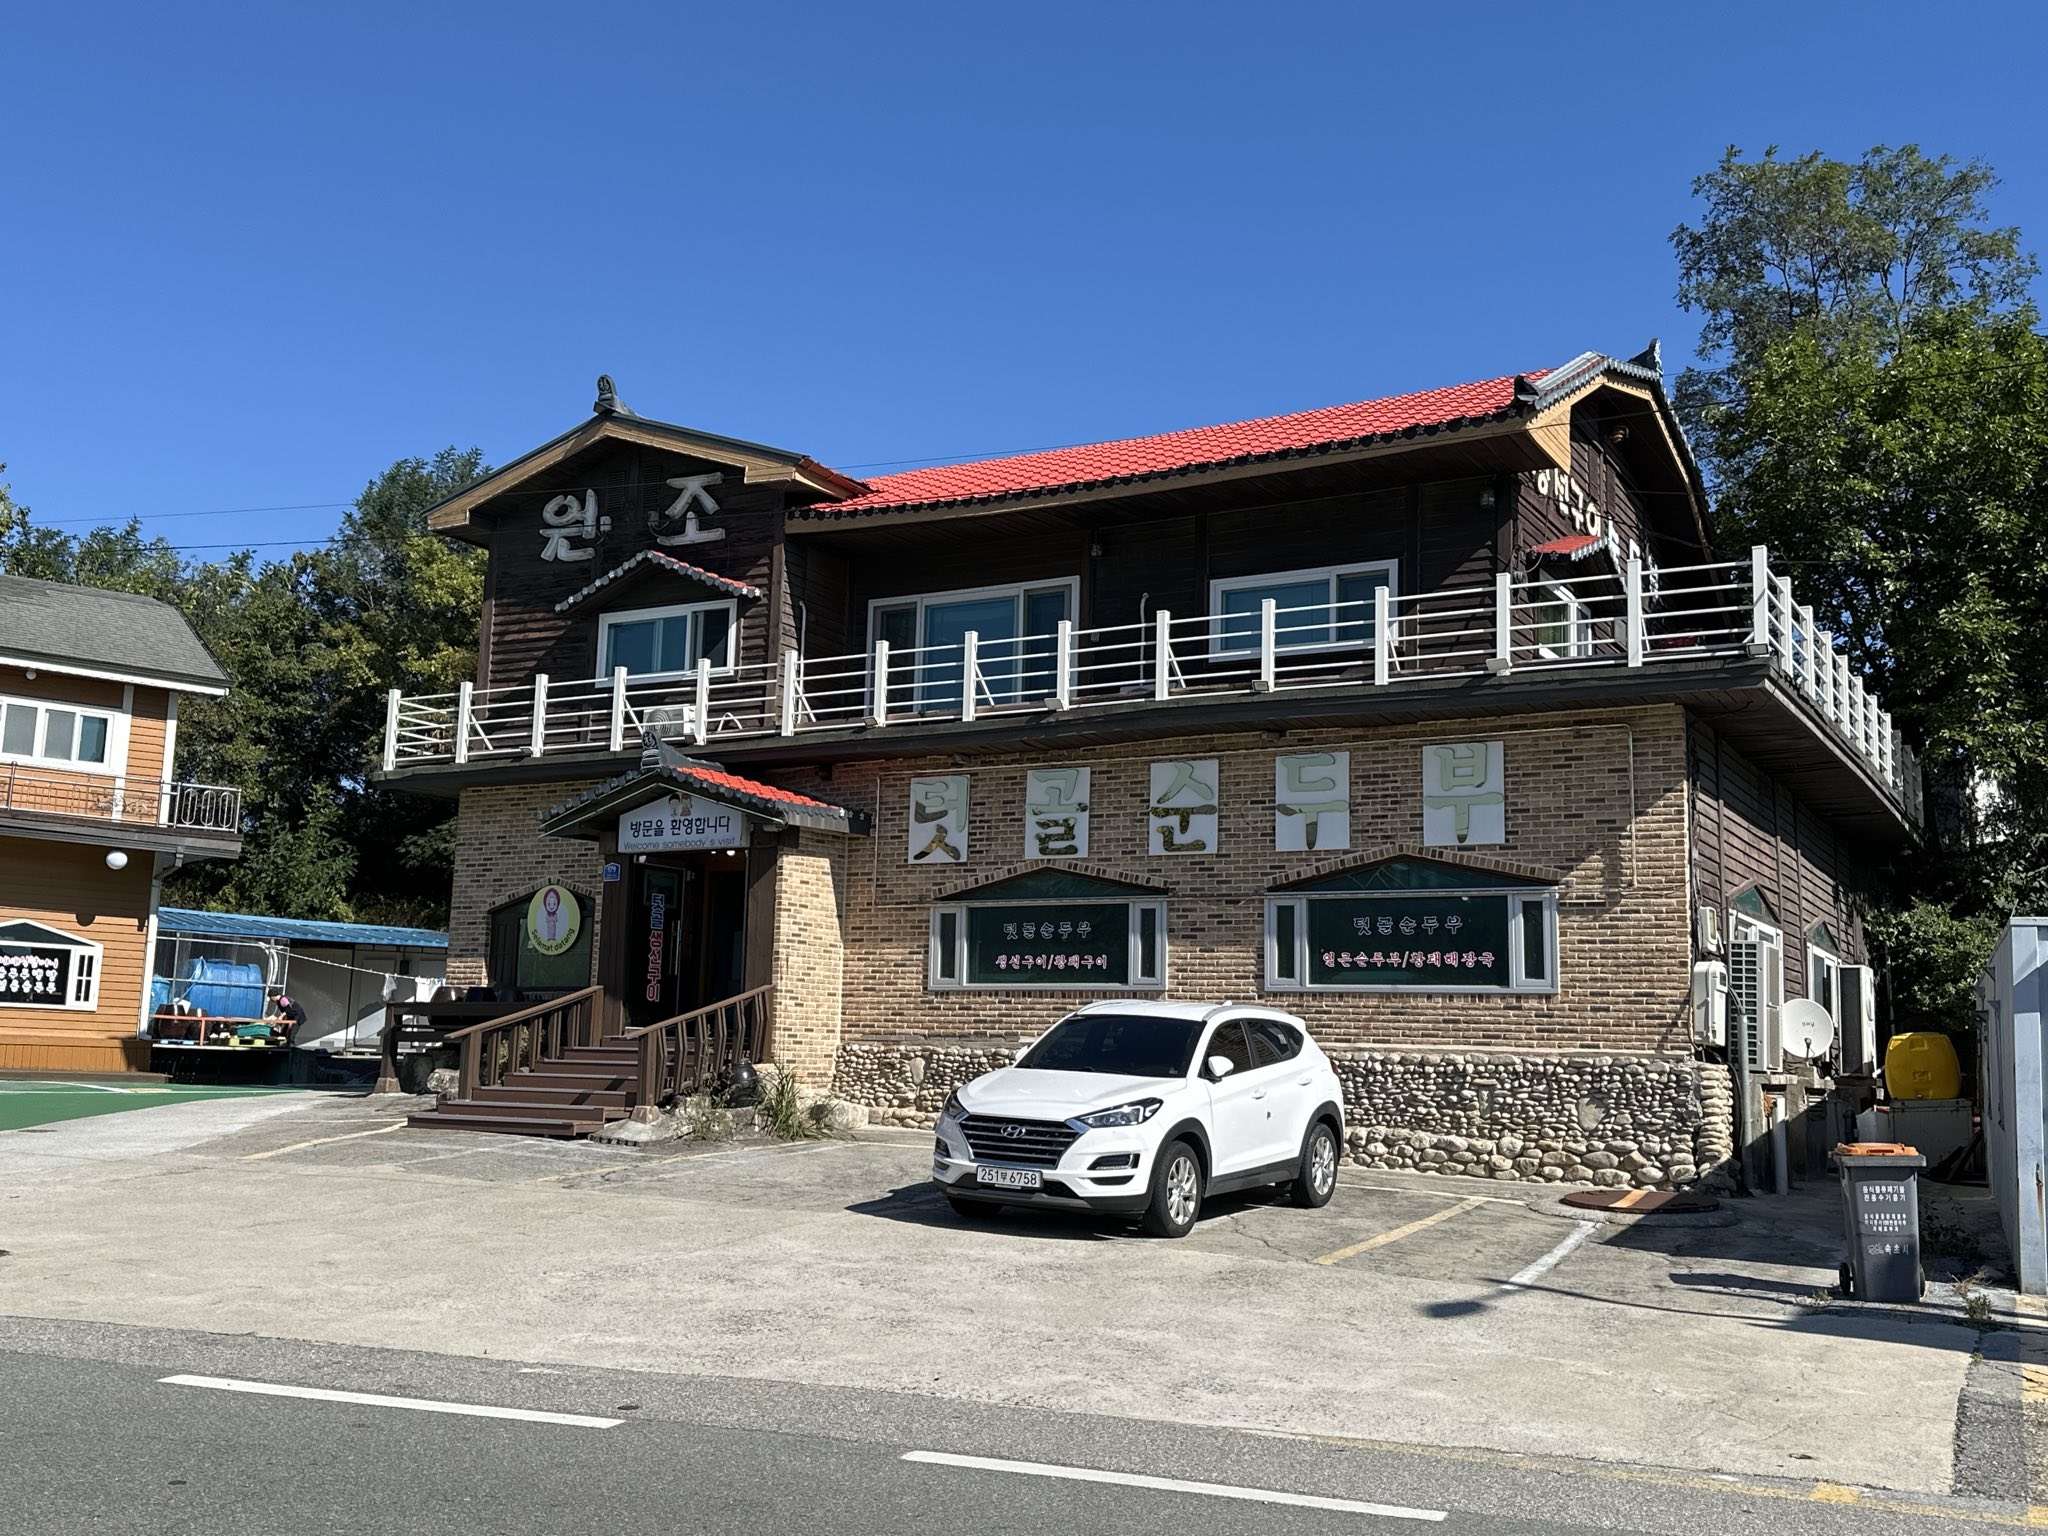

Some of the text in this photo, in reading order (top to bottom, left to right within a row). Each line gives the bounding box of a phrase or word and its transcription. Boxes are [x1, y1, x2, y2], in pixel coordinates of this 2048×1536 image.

[539, 472, 726, 562] 원조
[630, 815, 731, 838] 방문을 환영합니다
[624, 841, 660, 850] Welcome
[718, 837, 735, 846] visit
[1003, 921, 1092, 940] 텃골순두부
[1353, 915, 1463, 936] 텃골순두부
[531, 927, 576, 951] Selamat datang
[647, 930, 663, 1002] 생선구이
[1885, 1243, 1909, 1255] 속초시
